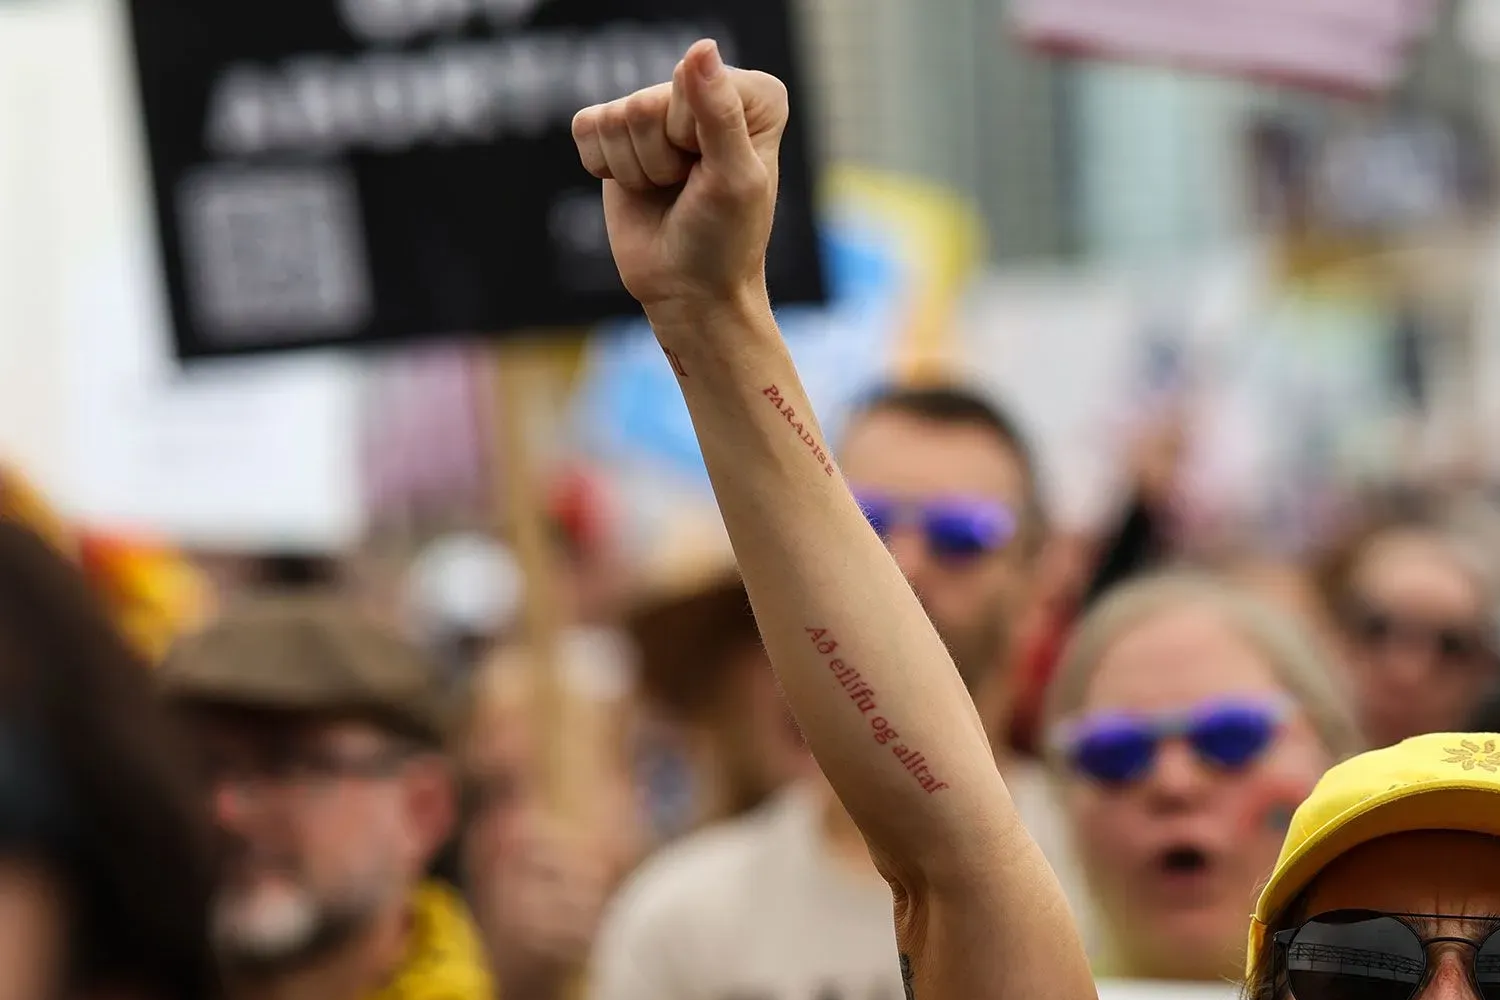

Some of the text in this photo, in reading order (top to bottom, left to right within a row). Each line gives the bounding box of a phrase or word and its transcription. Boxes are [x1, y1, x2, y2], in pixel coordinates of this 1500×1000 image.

[762, 384, 835, 477] PARADISE
[871, 716, 899, 745] og
[892, 744, 949, 794] alltaf
